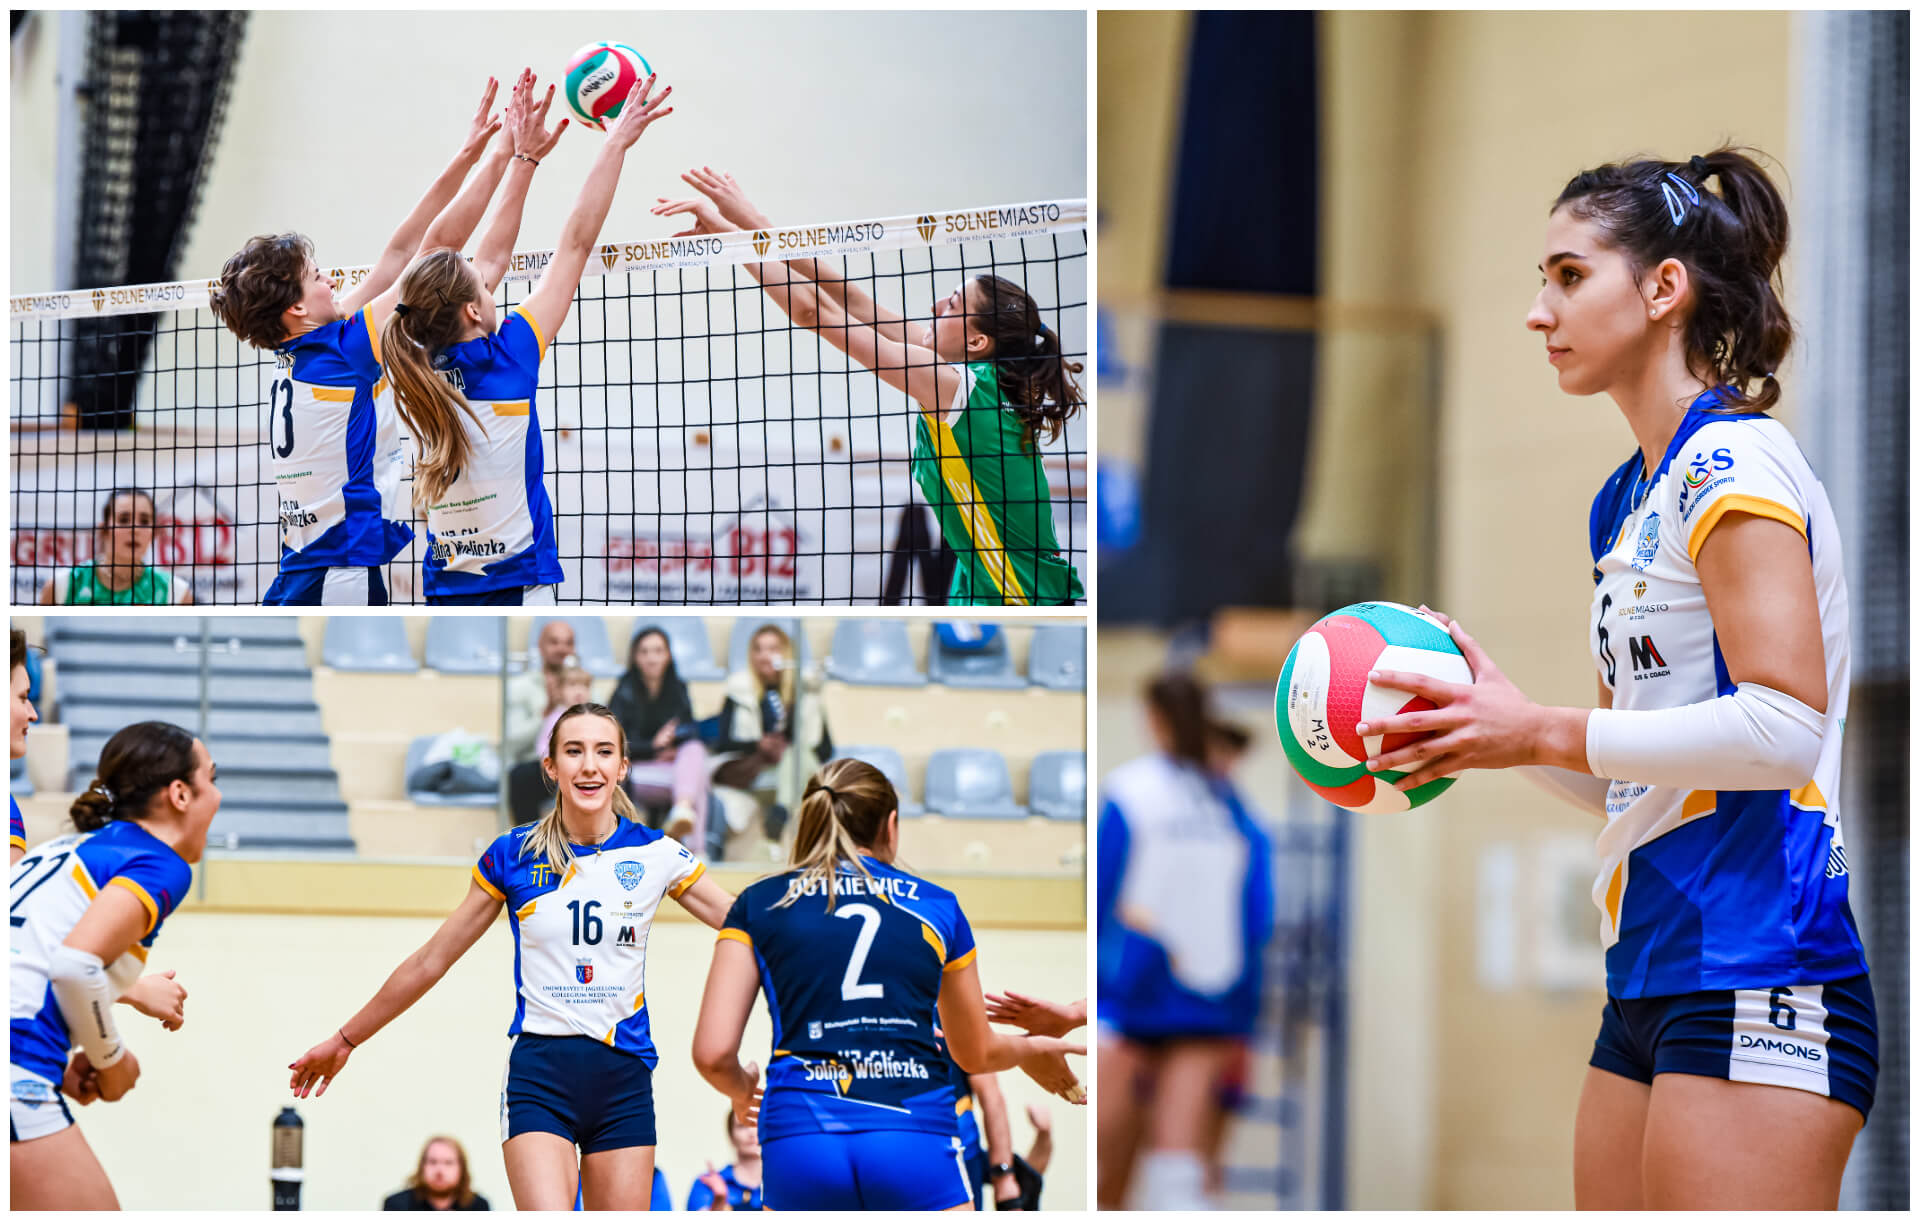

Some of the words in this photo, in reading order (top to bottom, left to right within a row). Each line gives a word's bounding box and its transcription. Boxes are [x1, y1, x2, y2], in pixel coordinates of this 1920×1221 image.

[944, 203, 1060, 233] SOLNEMIASTO
[778, 222, 884, 249] SOLNEMIASTO
[625, 238, 723, 262] SOLNEMIASTO
[10, 295, 71, 313] LNEMIASTO
[110, 285, 185, 305] SOLNEMIASTO
[566, 899, 603, 946] 16
[834, 902, 884, 1001] 2
[1768, 986, 1797, 1031] 6
[1740, 1034, 1822, 1061] DAMONS
[804, 1059, 849, 1082] Solna
[851, 1056, 930, 1080] Wieliczka
